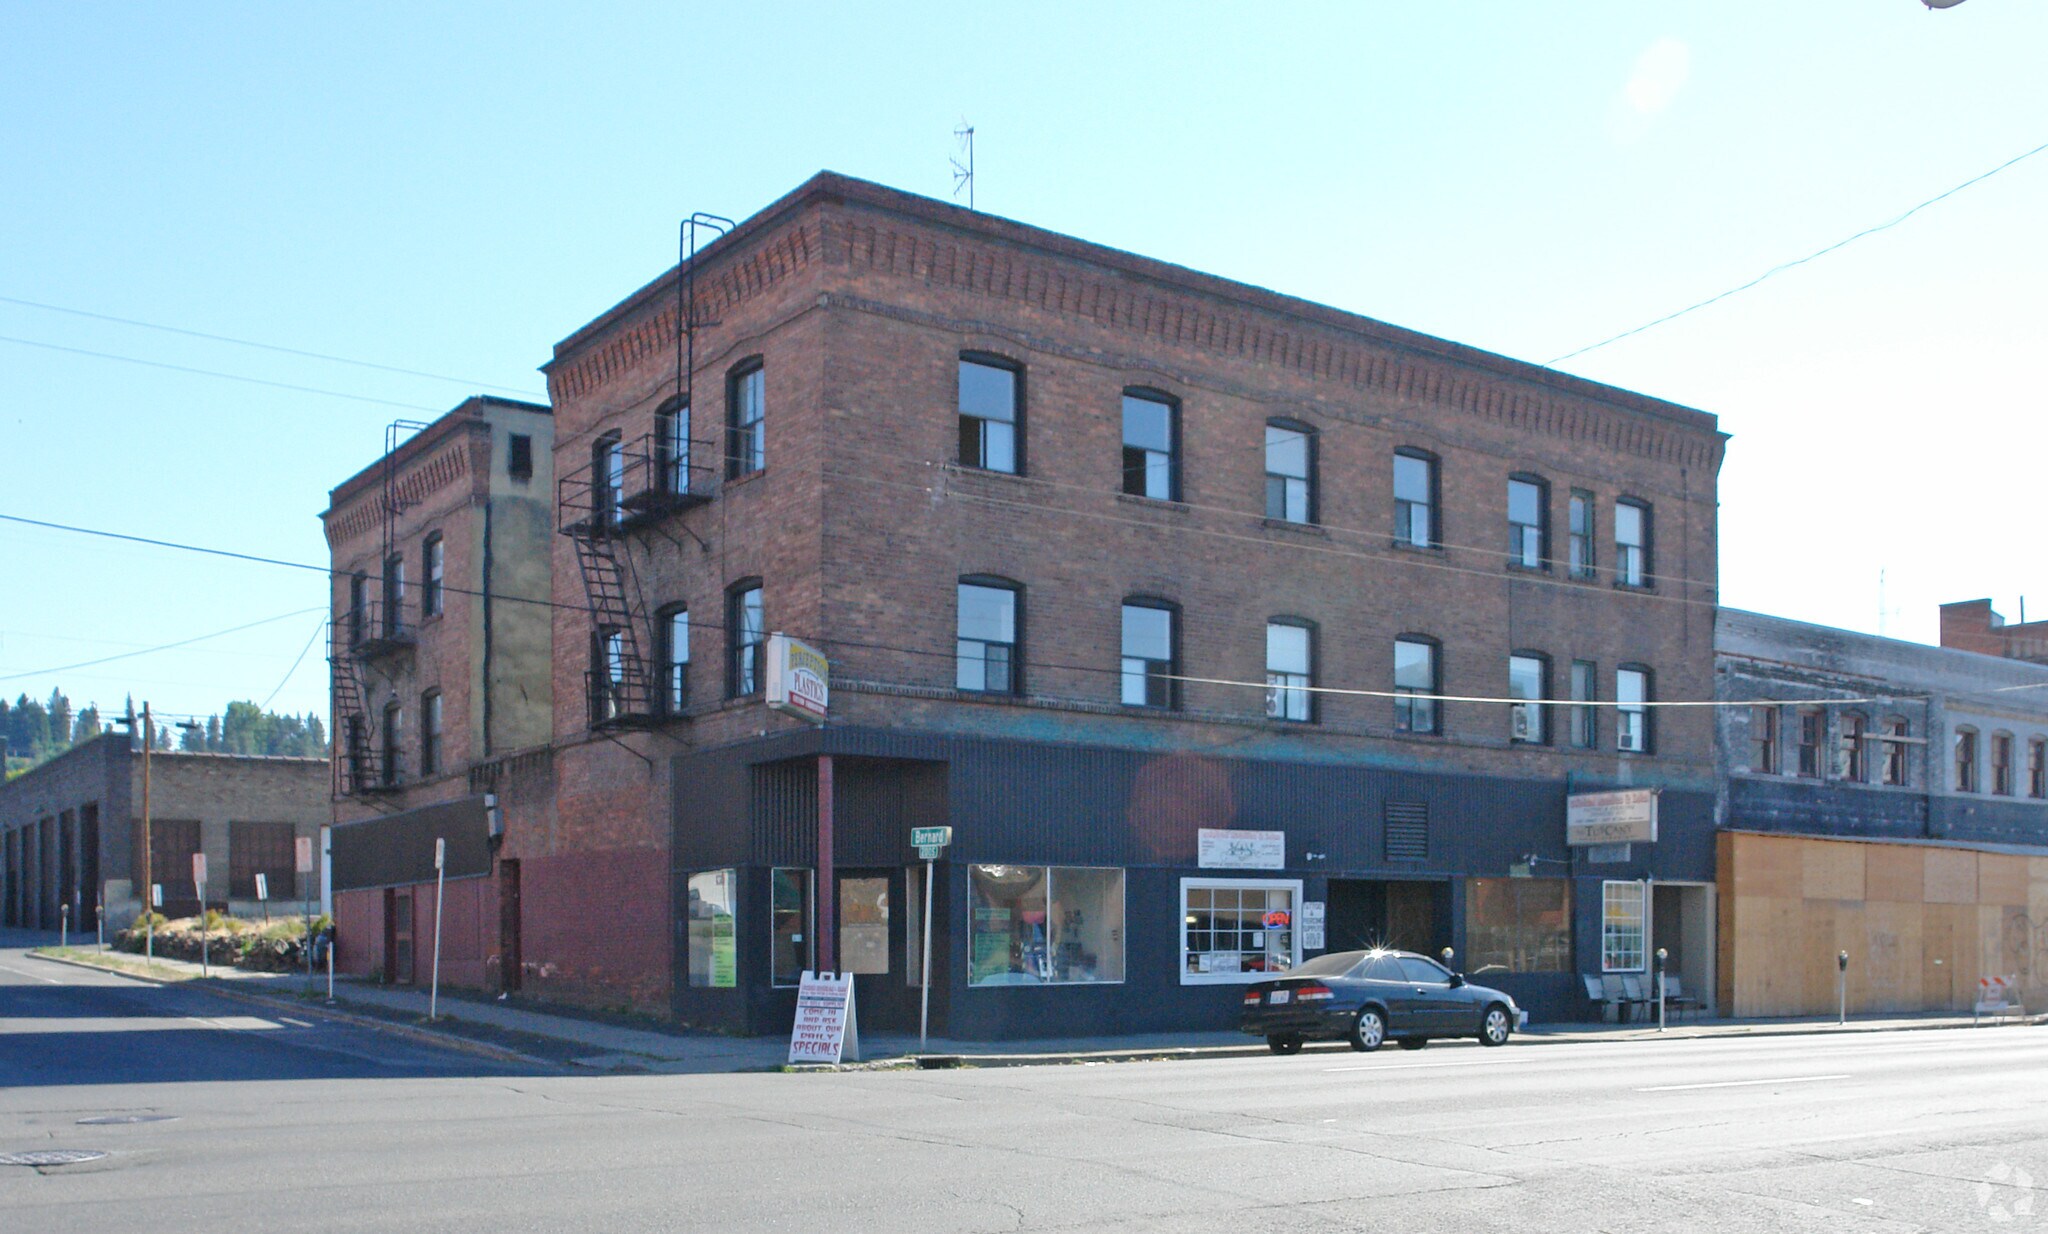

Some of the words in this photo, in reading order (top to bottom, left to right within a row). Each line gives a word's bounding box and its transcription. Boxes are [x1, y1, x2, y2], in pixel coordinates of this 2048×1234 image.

[794, 672, 824, 702] PLASTICS
[915, 830, 944, 844] Bernard
[1262, 912, 1290, 925] OPEN
[796, 1024, 822, 1032] ABOUT
[800, 1032, 834, 1040] DAILY
[793, 1041, 839, 1056] SPECIALS
